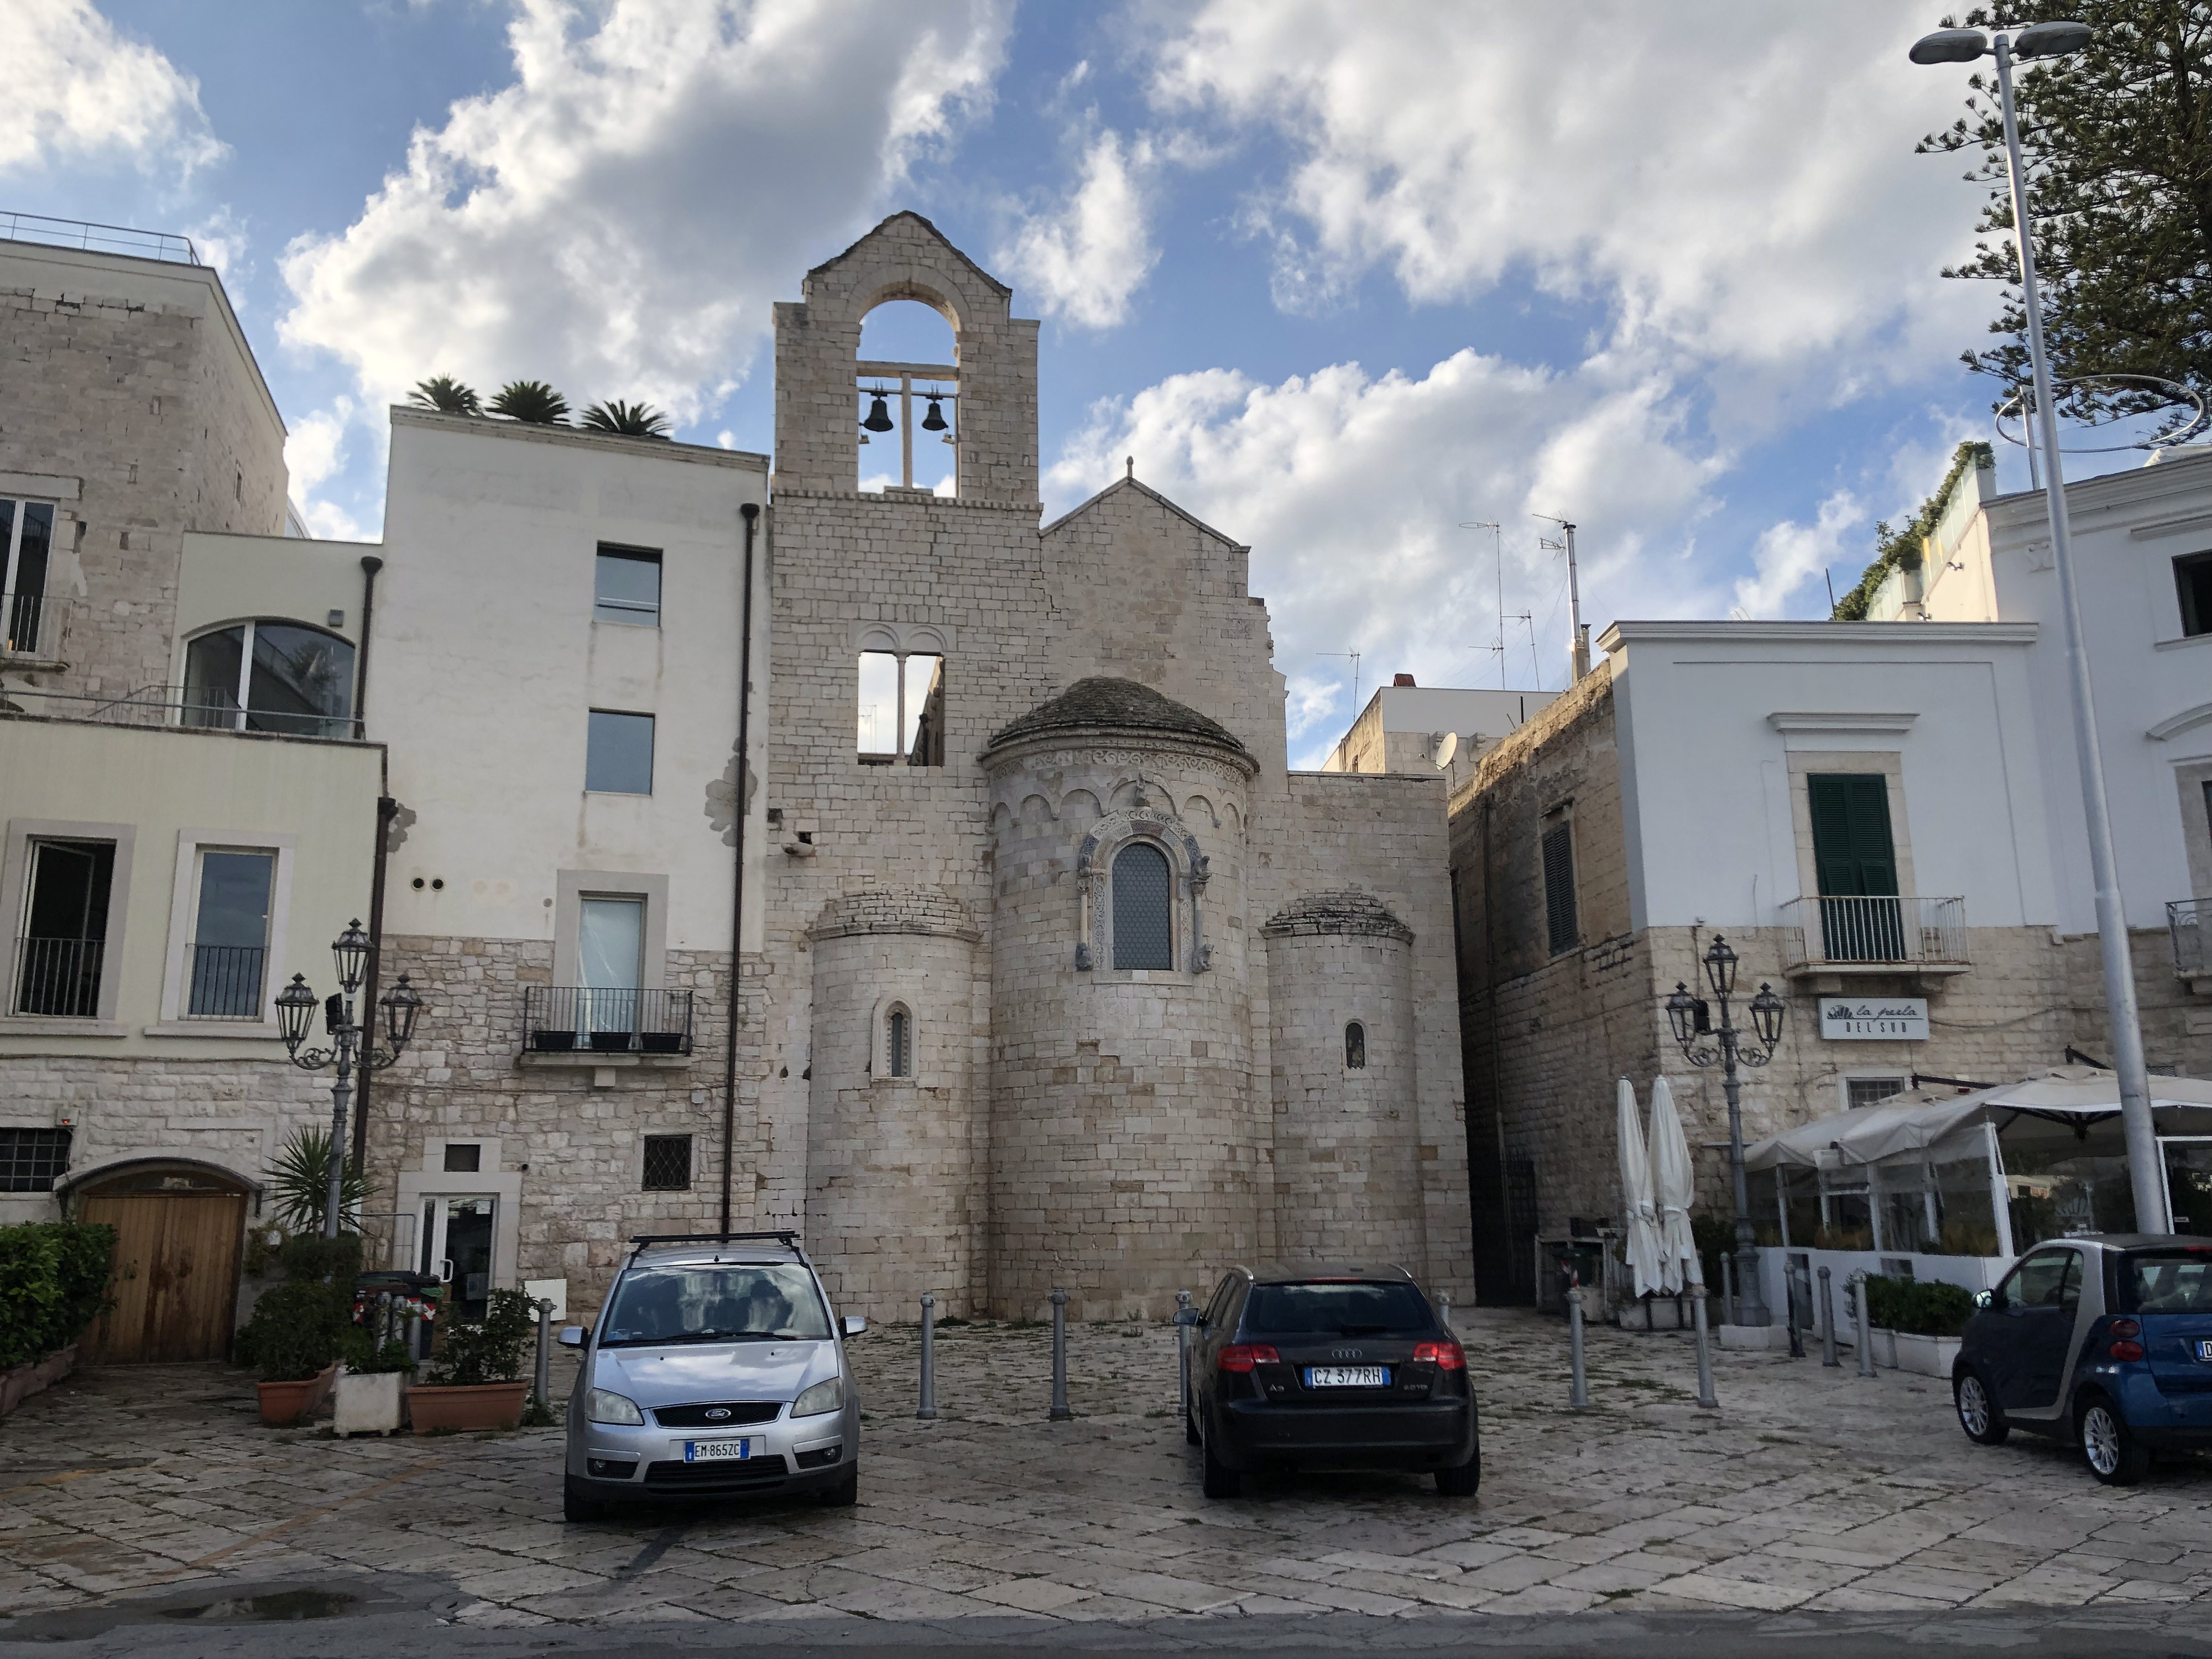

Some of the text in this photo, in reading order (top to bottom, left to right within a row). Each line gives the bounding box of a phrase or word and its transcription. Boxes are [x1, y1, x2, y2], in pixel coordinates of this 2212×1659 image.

[1856, 1005, 1917, 1021] la perla
[1846, 1022, 1906, 1032] DEL SUD
[1314, 1368, 1381, 1384] CZ 377RH
[695, 1443, 739, 1457] EM 865ZC
